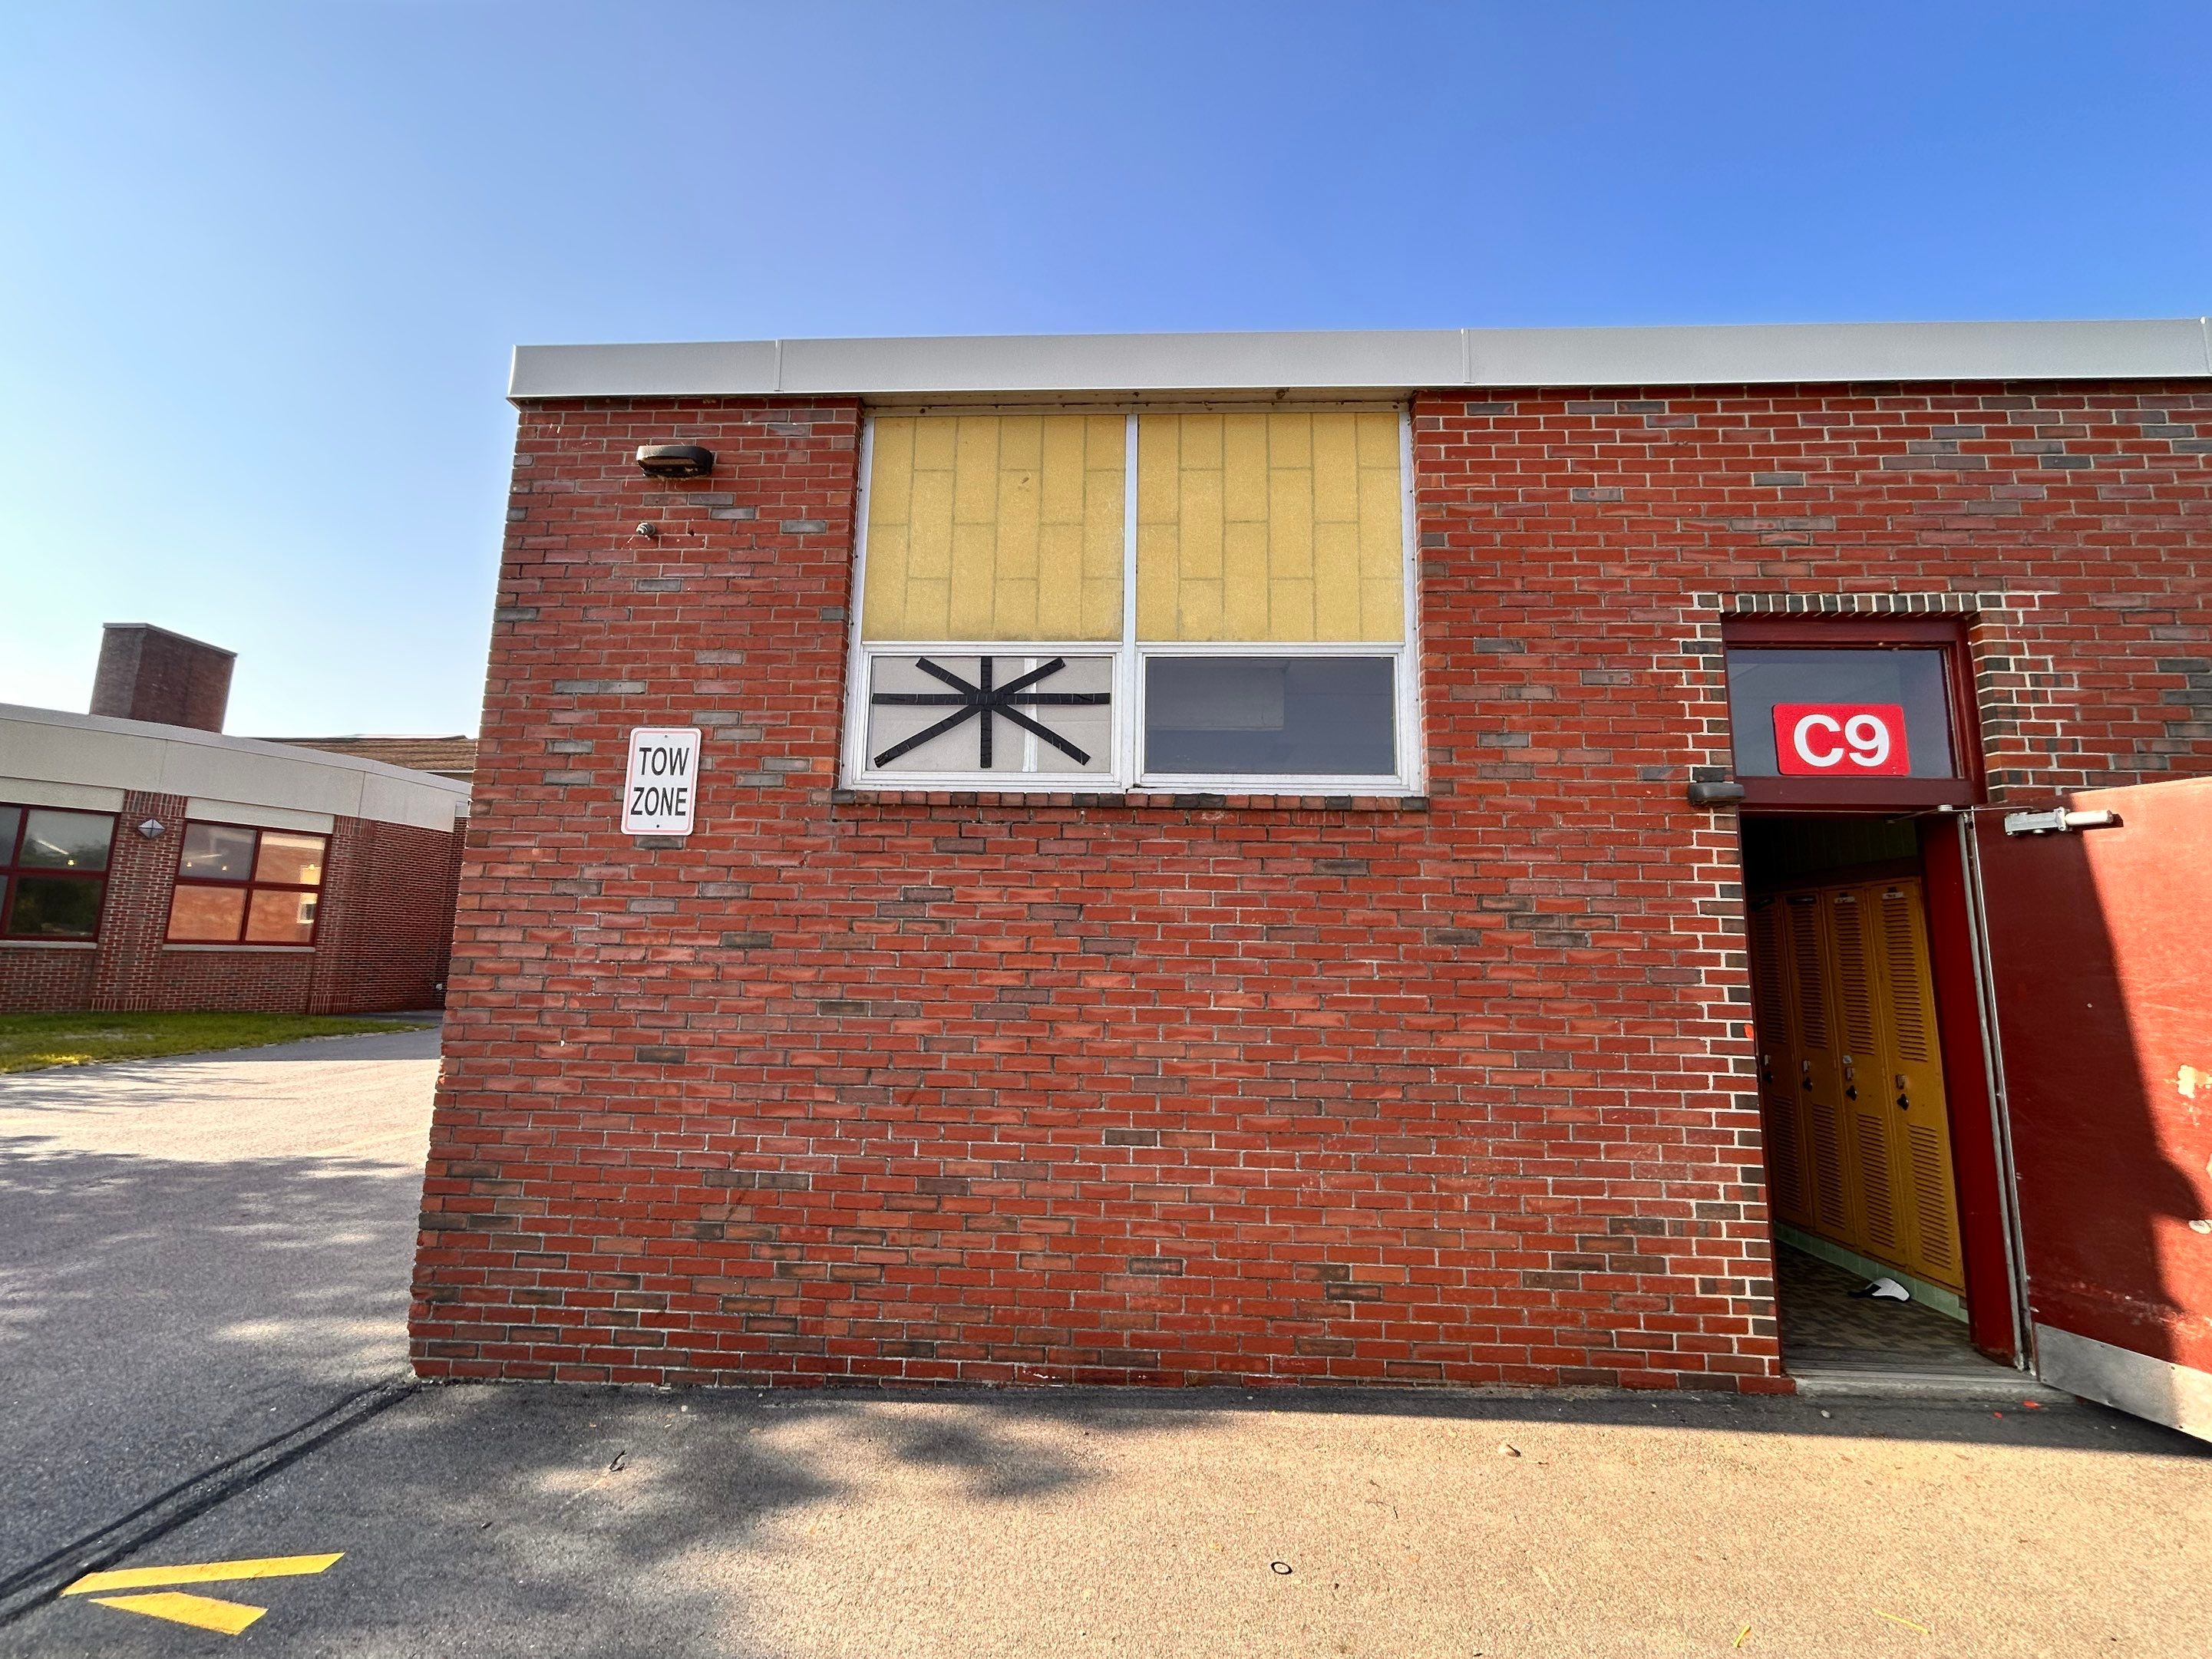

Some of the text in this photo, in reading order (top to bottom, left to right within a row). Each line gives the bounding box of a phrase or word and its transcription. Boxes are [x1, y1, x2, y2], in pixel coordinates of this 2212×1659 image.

[1793, 714, 1890, 767] C9
[639, 747, 689, 776] TOW
[631, 787, 688, 816] ZONE
